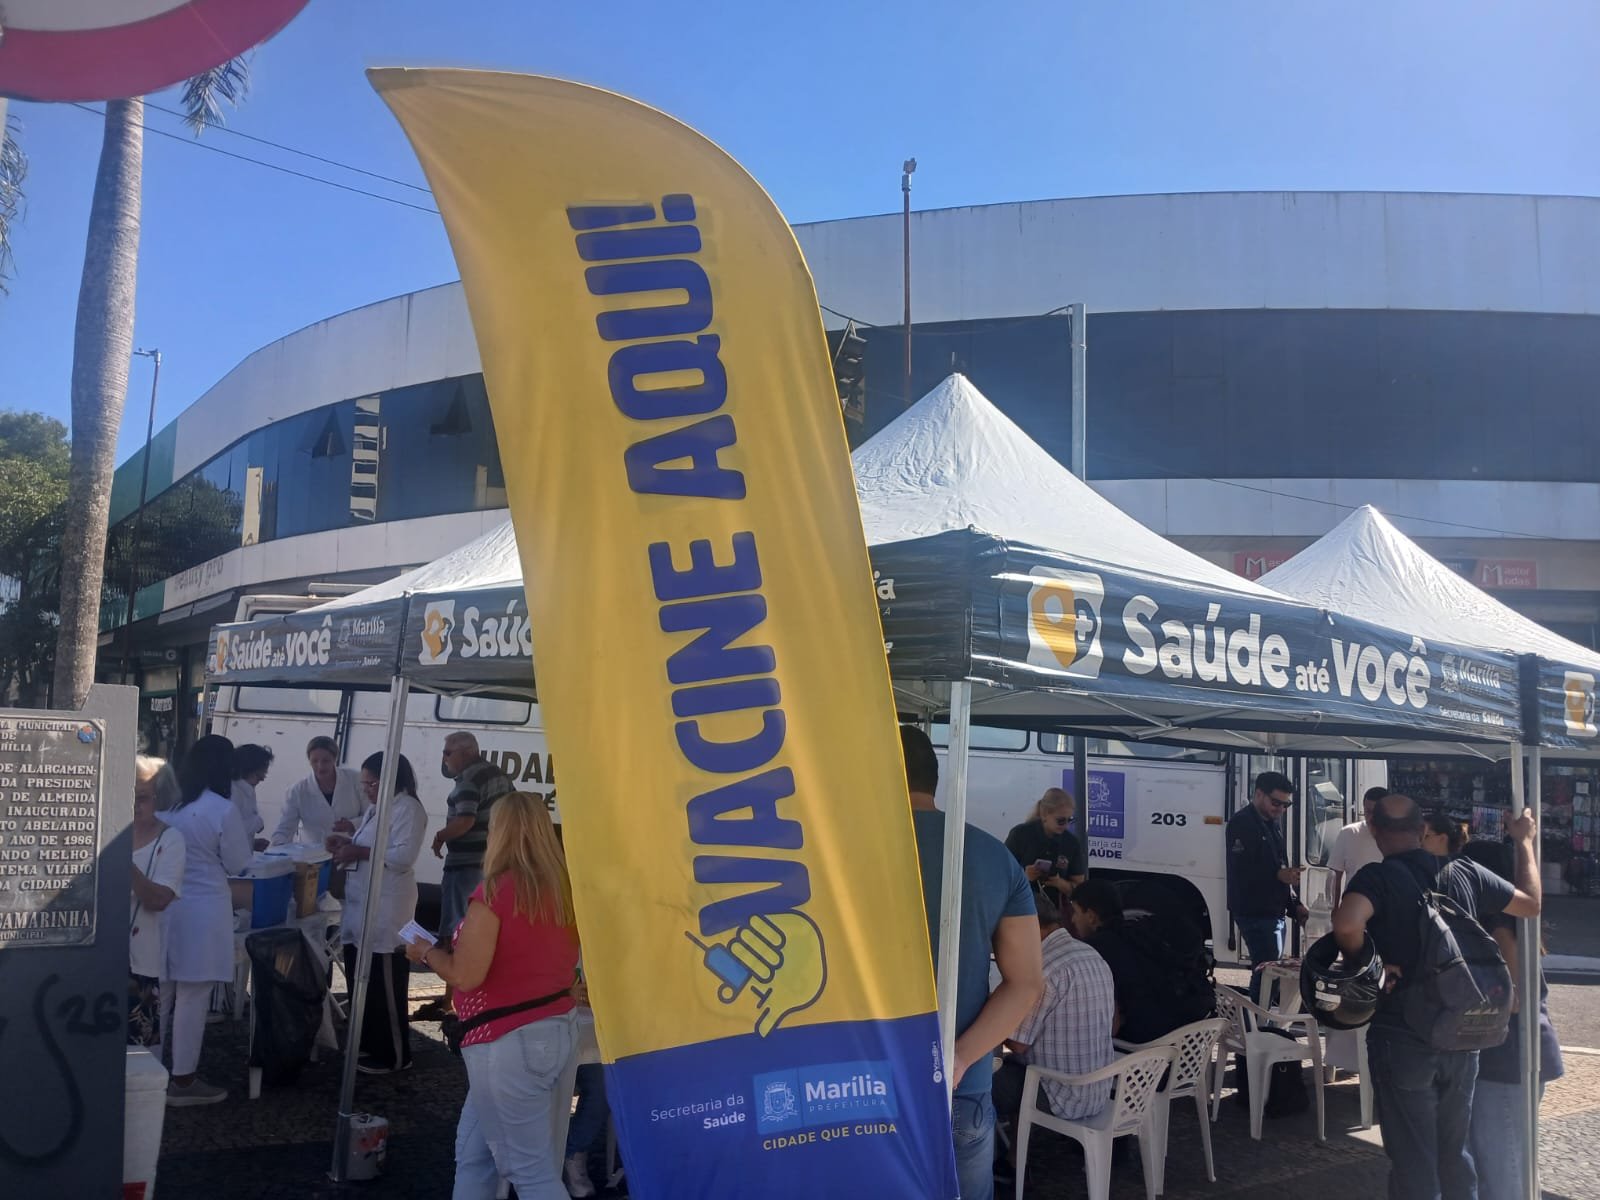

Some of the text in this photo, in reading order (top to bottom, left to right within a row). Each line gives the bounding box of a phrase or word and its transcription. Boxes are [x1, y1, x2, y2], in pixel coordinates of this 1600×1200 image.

[566, 193, 811, 937] VACINE AQUI!
[352, 616, 385, 636] Marília
[460, 599, 533, 657] Saú
[230, 630, 272, 671] Saúde
[271, 646, 285, 666] até
[1122, 593, 1290, 689] Saúde
[1296, 659, 1330, 693] até
[1459, 659, 1501, 688] Marília
[18, 721, 74, 731] MUNICIPAL
[0, 742, 31, 752] RÍLIA
[12, 791, 30, 802] DE
[39, 793, 96, 803] ALMEIDA
[24, 821, 95, 831] ABELARDO
[1089, 814, 1118, 827] rília
[1151, 812, 1187, 827] 203
[10, 835, 36, 845] ANO
[41, 836, 58, 845] DE
[1088, 840, 1109, 848] taria
[1089, 847, 1122, 859] AÚDE
[46, 861, 92, 875] VIÁRIO
[0, 911, 89, 929] AMARINHA
[805, 1075, 887, 1102] Marília
[650, 1094, 745, 1122] Secretaria da
[809, 1099, 887, 1113] PREFEITURA
[703, 1110, 746, 1129] Saúde
[763, 1122, 897, 1151] CIDADE QUE CUIDA
